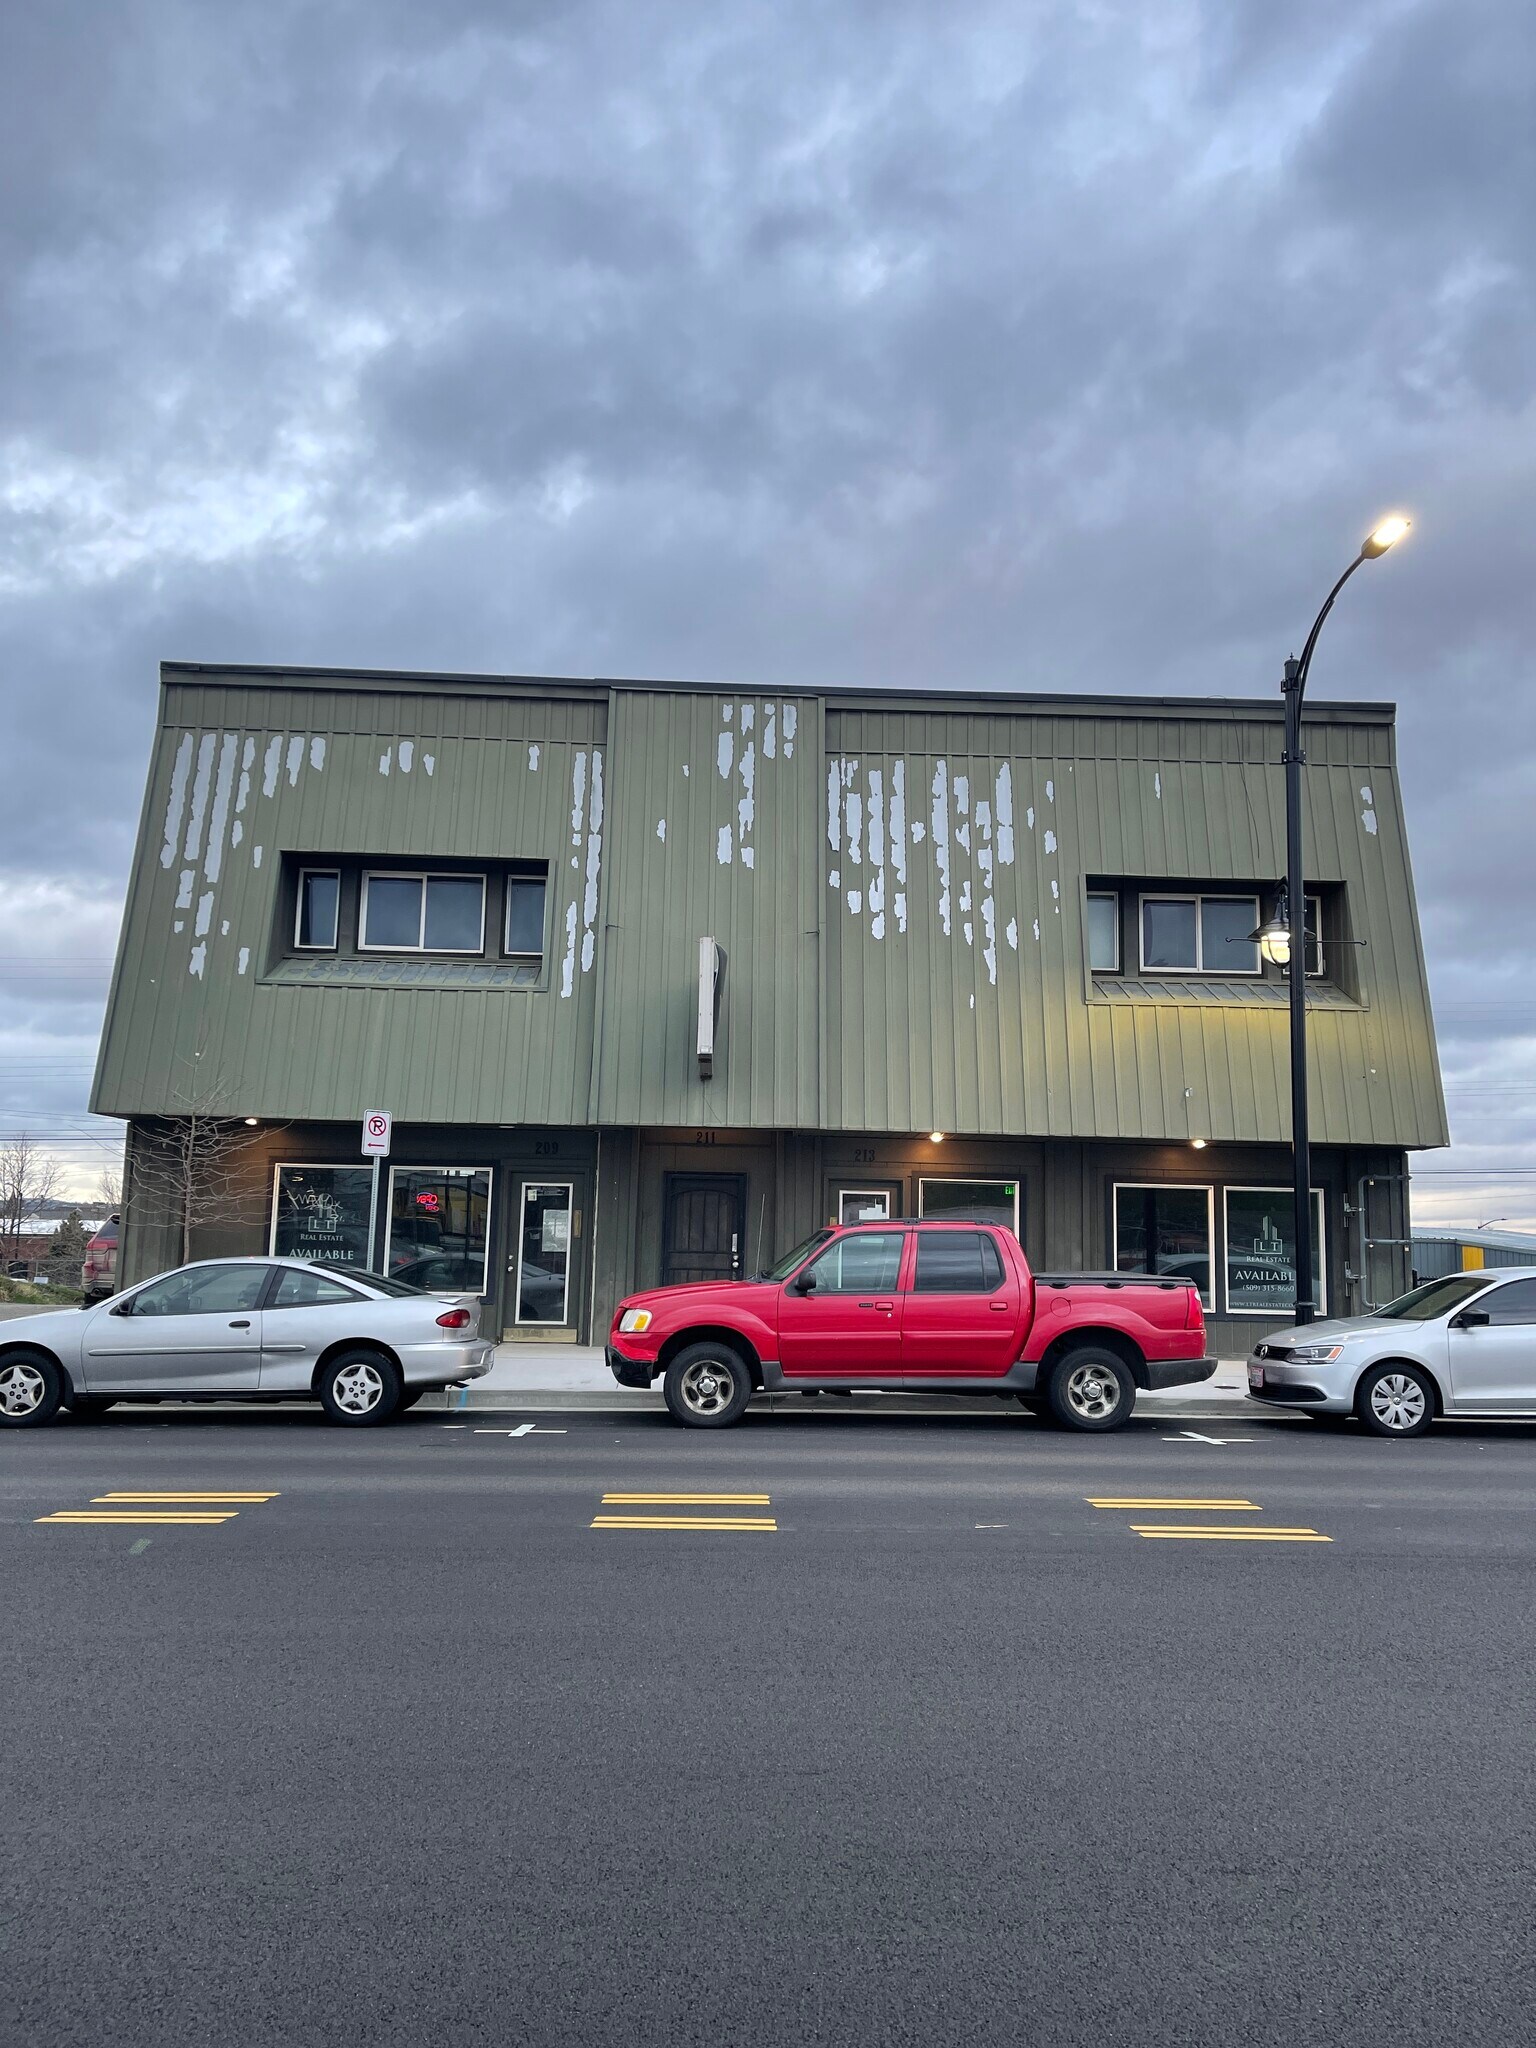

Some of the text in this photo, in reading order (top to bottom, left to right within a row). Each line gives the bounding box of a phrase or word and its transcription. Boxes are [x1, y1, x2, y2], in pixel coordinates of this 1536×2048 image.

[696, 1132, 716, 1144] 211
[535, 1141, 559, 1154] 209
[854, 1150, 875, 1162] 213
[288, 1249, 354, 1260] AVAILABLE
[1235, 1271, 1295, 1281] AVAILABL
[1242, 1284, 1261, 1292] (509)
